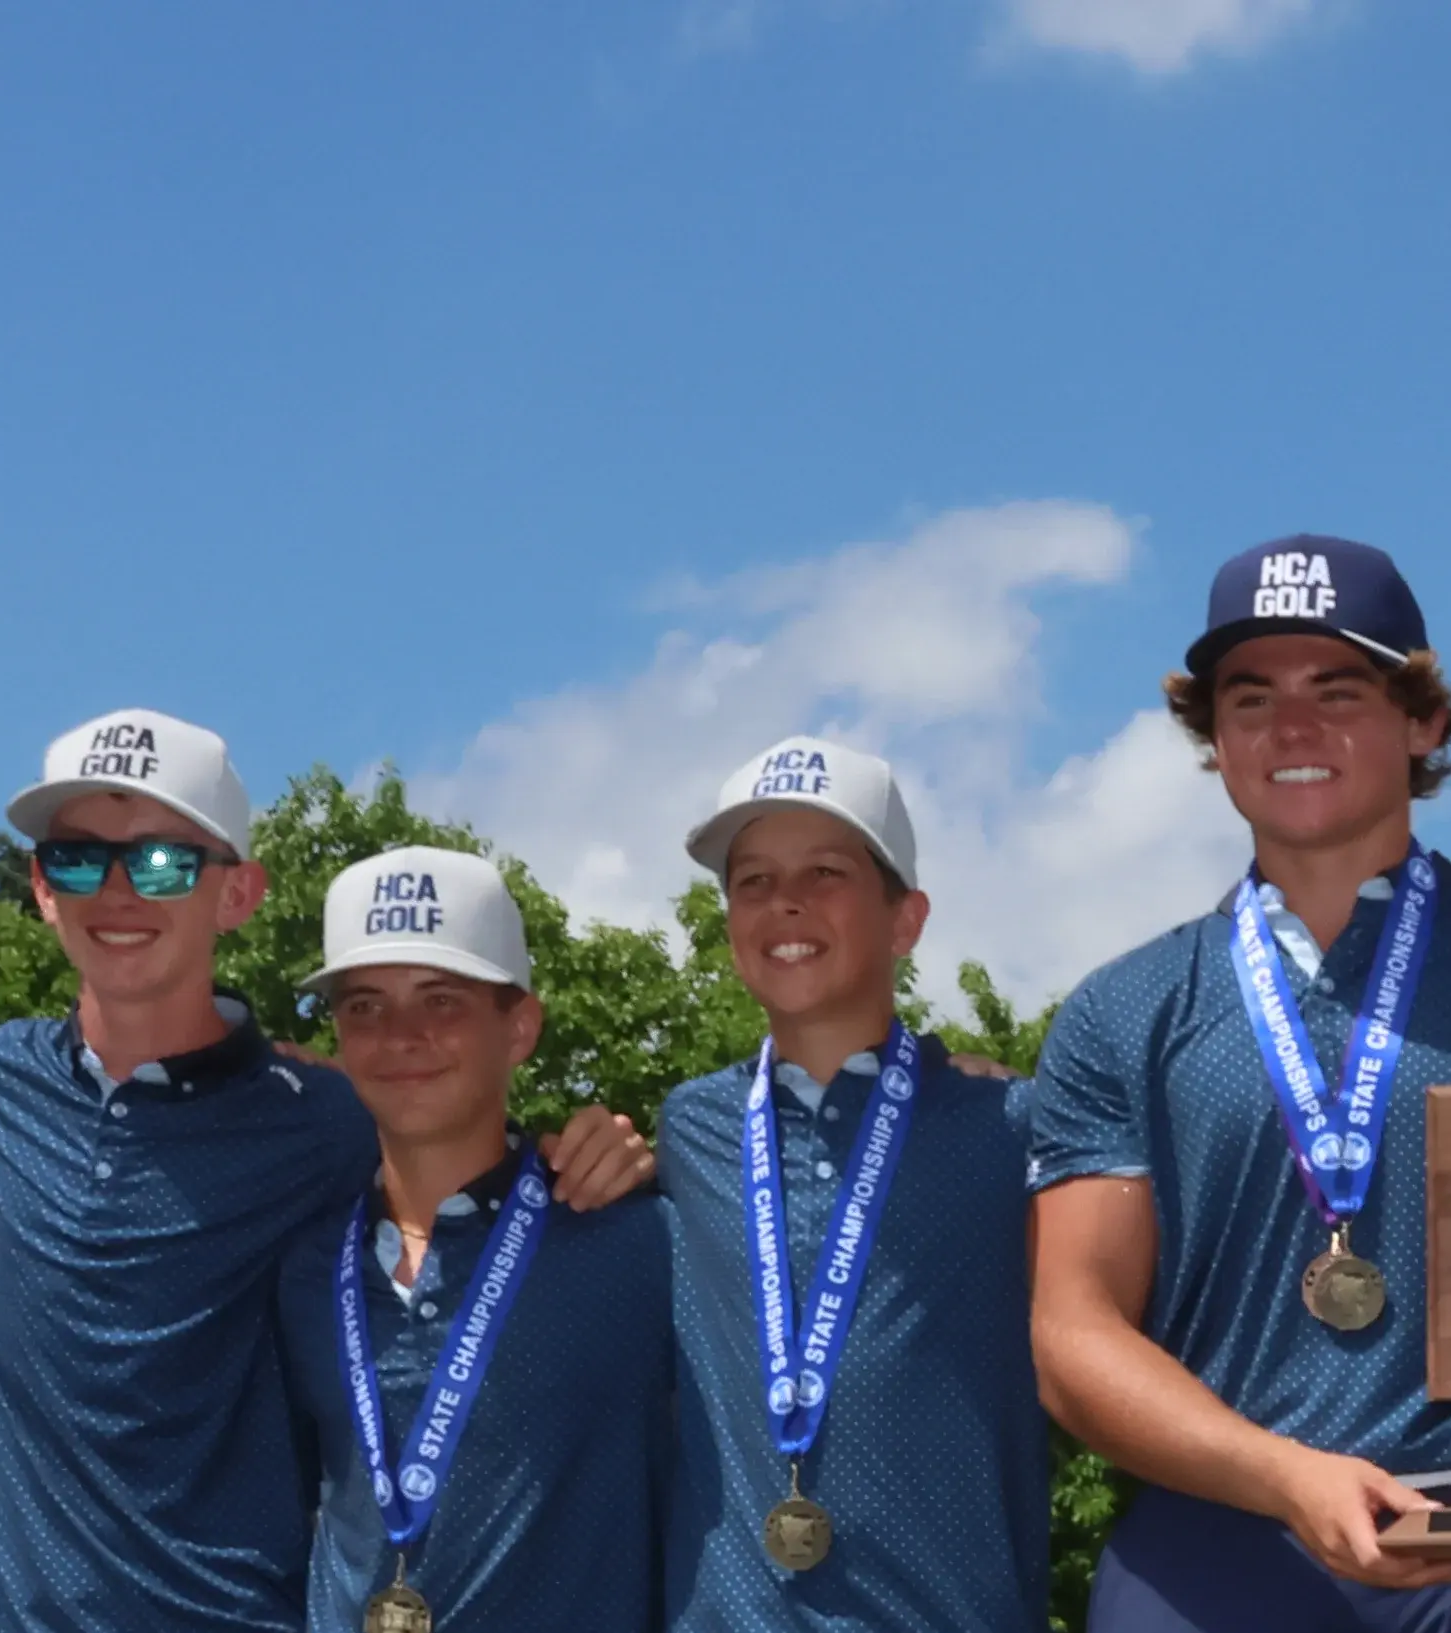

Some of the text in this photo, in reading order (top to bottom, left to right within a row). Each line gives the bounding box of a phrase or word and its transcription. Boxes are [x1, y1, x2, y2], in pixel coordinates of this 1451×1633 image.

[1260, 552, 1331, 587] HCA
[1253, 586, 1336, 618] GOLF
[91, 724, 157, 752] HCA
[79, 753, 160, 780] GOLF
[762, 749, 827, 775] HCA
[752, 773, 832, 799] GOLF
[374, 873, 438, 903] HCA
[365, 905, 444, 935] GOLF
[1349, 889, 1426, 1126] STATE CHAMPIONSHIPS
[1251, 967, 1328, 1132] CHAMPIONSHIPS
[749, 1111, 789, 1375] STATE CHAMPIONSHIPS
[804, 1102, 900, 1365] STATE CHAMPIONSHIPS
[419, 1207, 534, 1460] STATE CHAMPIONSHIPS
[340, 1286, 382, 1468] CHAMPIONSHIPS
